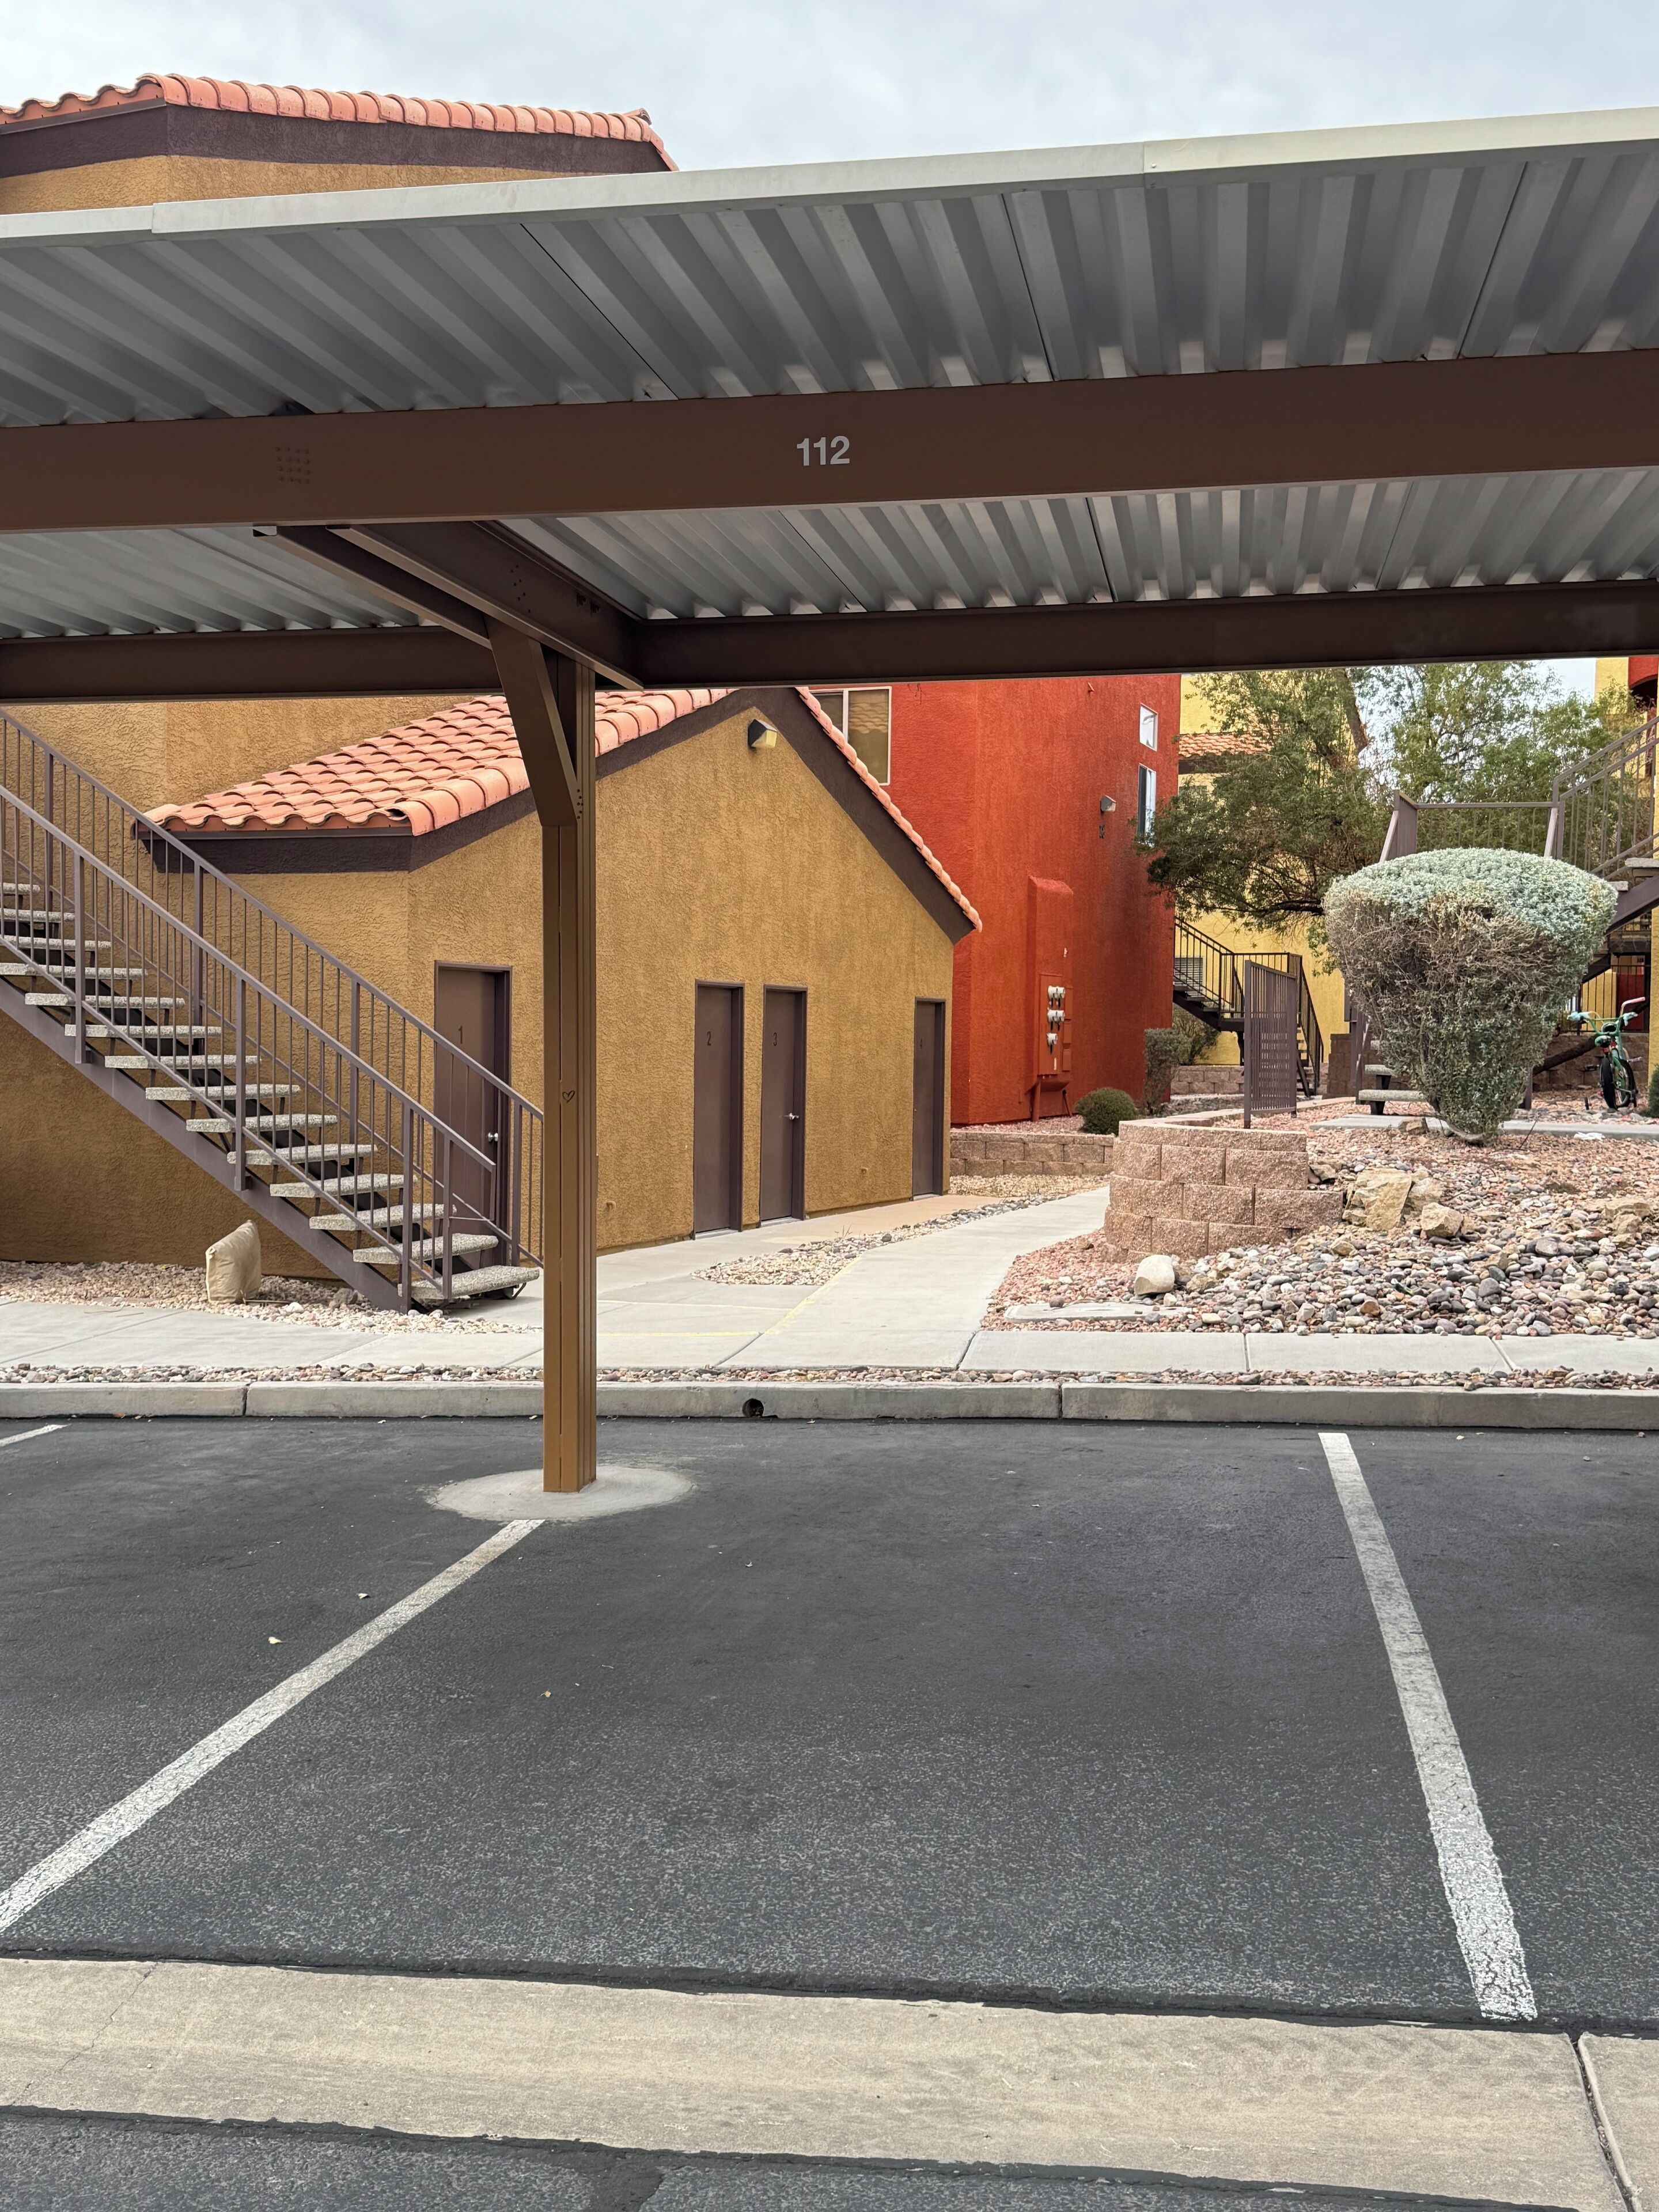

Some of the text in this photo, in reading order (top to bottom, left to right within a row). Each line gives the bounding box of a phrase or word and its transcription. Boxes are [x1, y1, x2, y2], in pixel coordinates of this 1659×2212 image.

[797, 435, 850, 466] 112
[458, 1025, 463, 1044] 1
[707, 1031, 711, 1046] 2
[773, 1032, 778, 1047] 3
